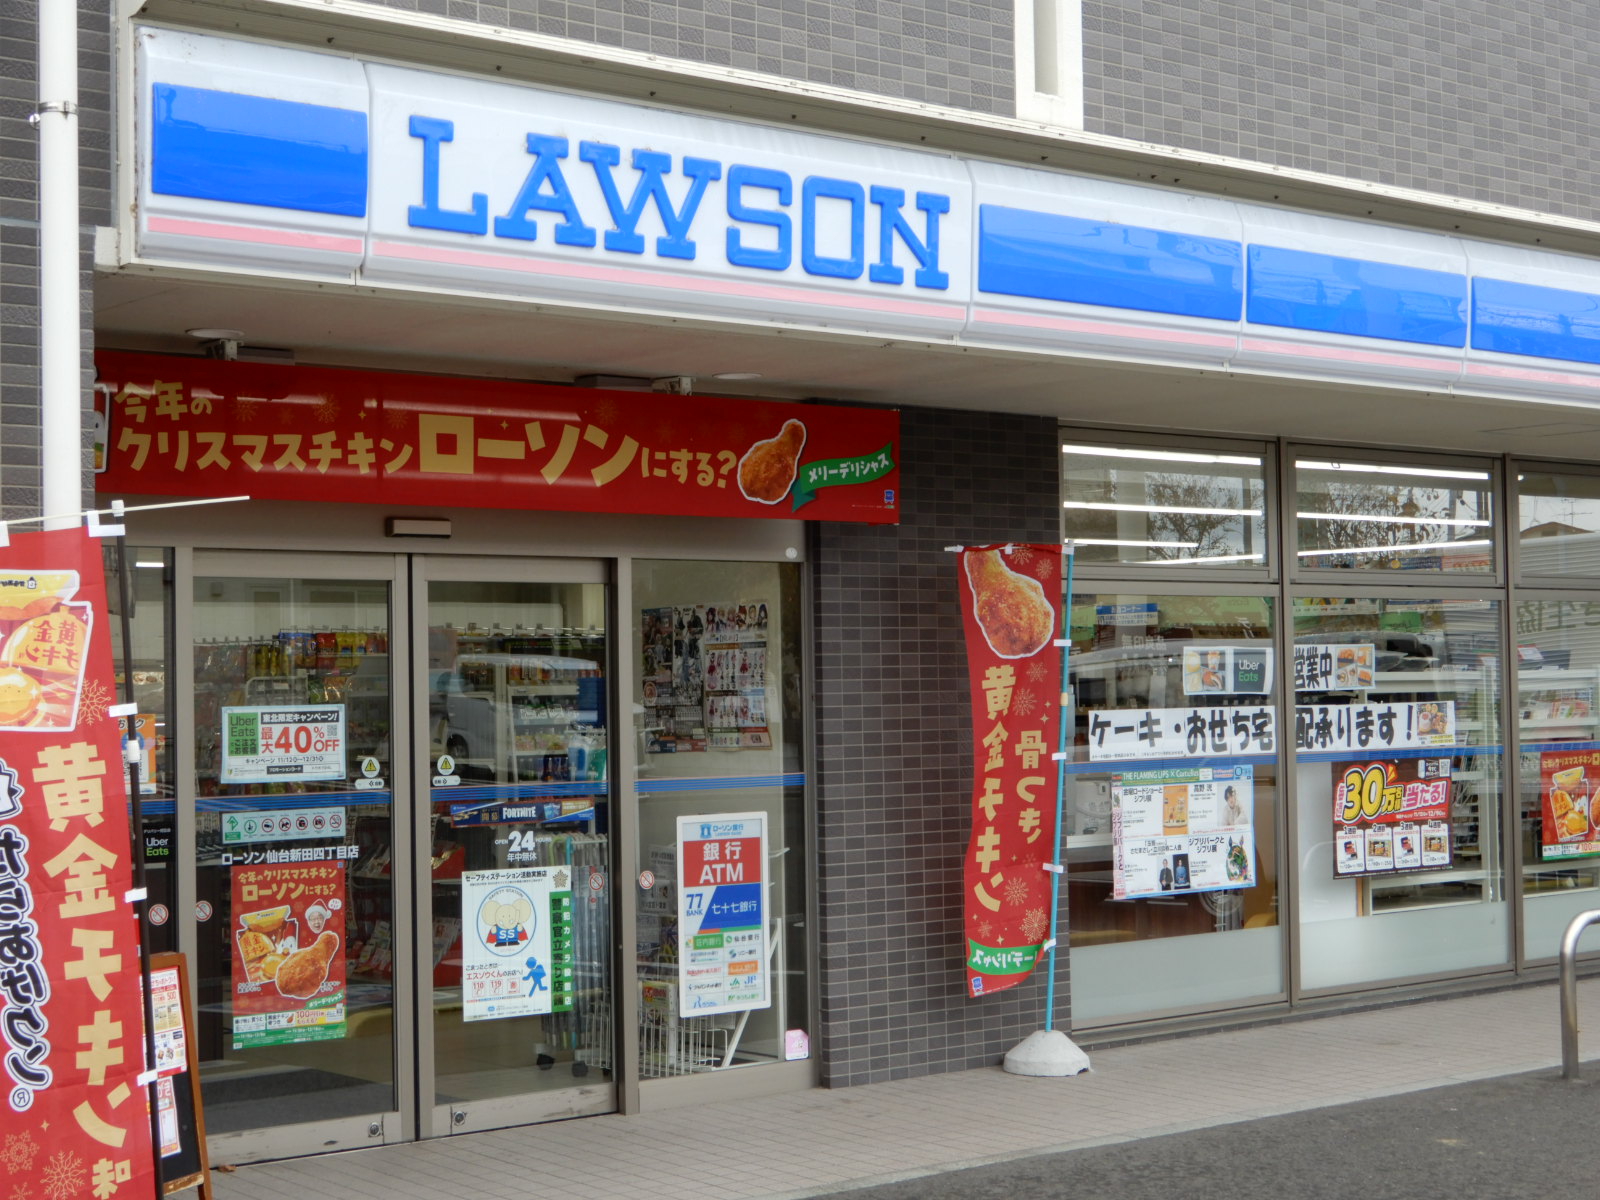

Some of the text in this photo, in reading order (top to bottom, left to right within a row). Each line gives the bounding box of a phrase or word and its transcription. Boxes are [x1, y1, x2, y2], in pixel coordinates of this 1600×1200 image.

[408, 114, 951, 290] LAWSON
[114, 379, 213, 423] 今年の
[808, 452, 889, 484] メリーデリシャス
[1238, 659, 1259, 670] Uber
[1294, 645, 1333, 689] 営業中
[1238, 672, 1259, 682] Eats
[118, 718, 145, 729] おク
[230, 715, 257, 726] Uber
[231, 727, 256, 737] Eats
[261, 726, 273, 753] 最大
[1123, 771, 1133, 780] THE
[1133, 770, 1158, 779] FLAMING
[1158, 768, 1169, 778] LIPS
[502, 806, 537, 820] FORTNITE
[712, 823, 744, 832] ローソン銀行
[146, 837, 169, 847] Uber
[508, 830, 536, 852] 24
[146, 847, 169, 857] Eats
[507, 852, 538, 862] 年中無休
[703, 841, 742, 861] 銀行
[238, 866, 338, 884] 今年のクリスマスチキン
[700, 863, 743, 884] ATM
[686, 893, 703, 910] 77
[712, 900, 758, 915] 七十七銀行
[686, 909, 703, 917] BANK
[499, 928, 515, 940] SS
[473, 979, 502, 990] 110 119
